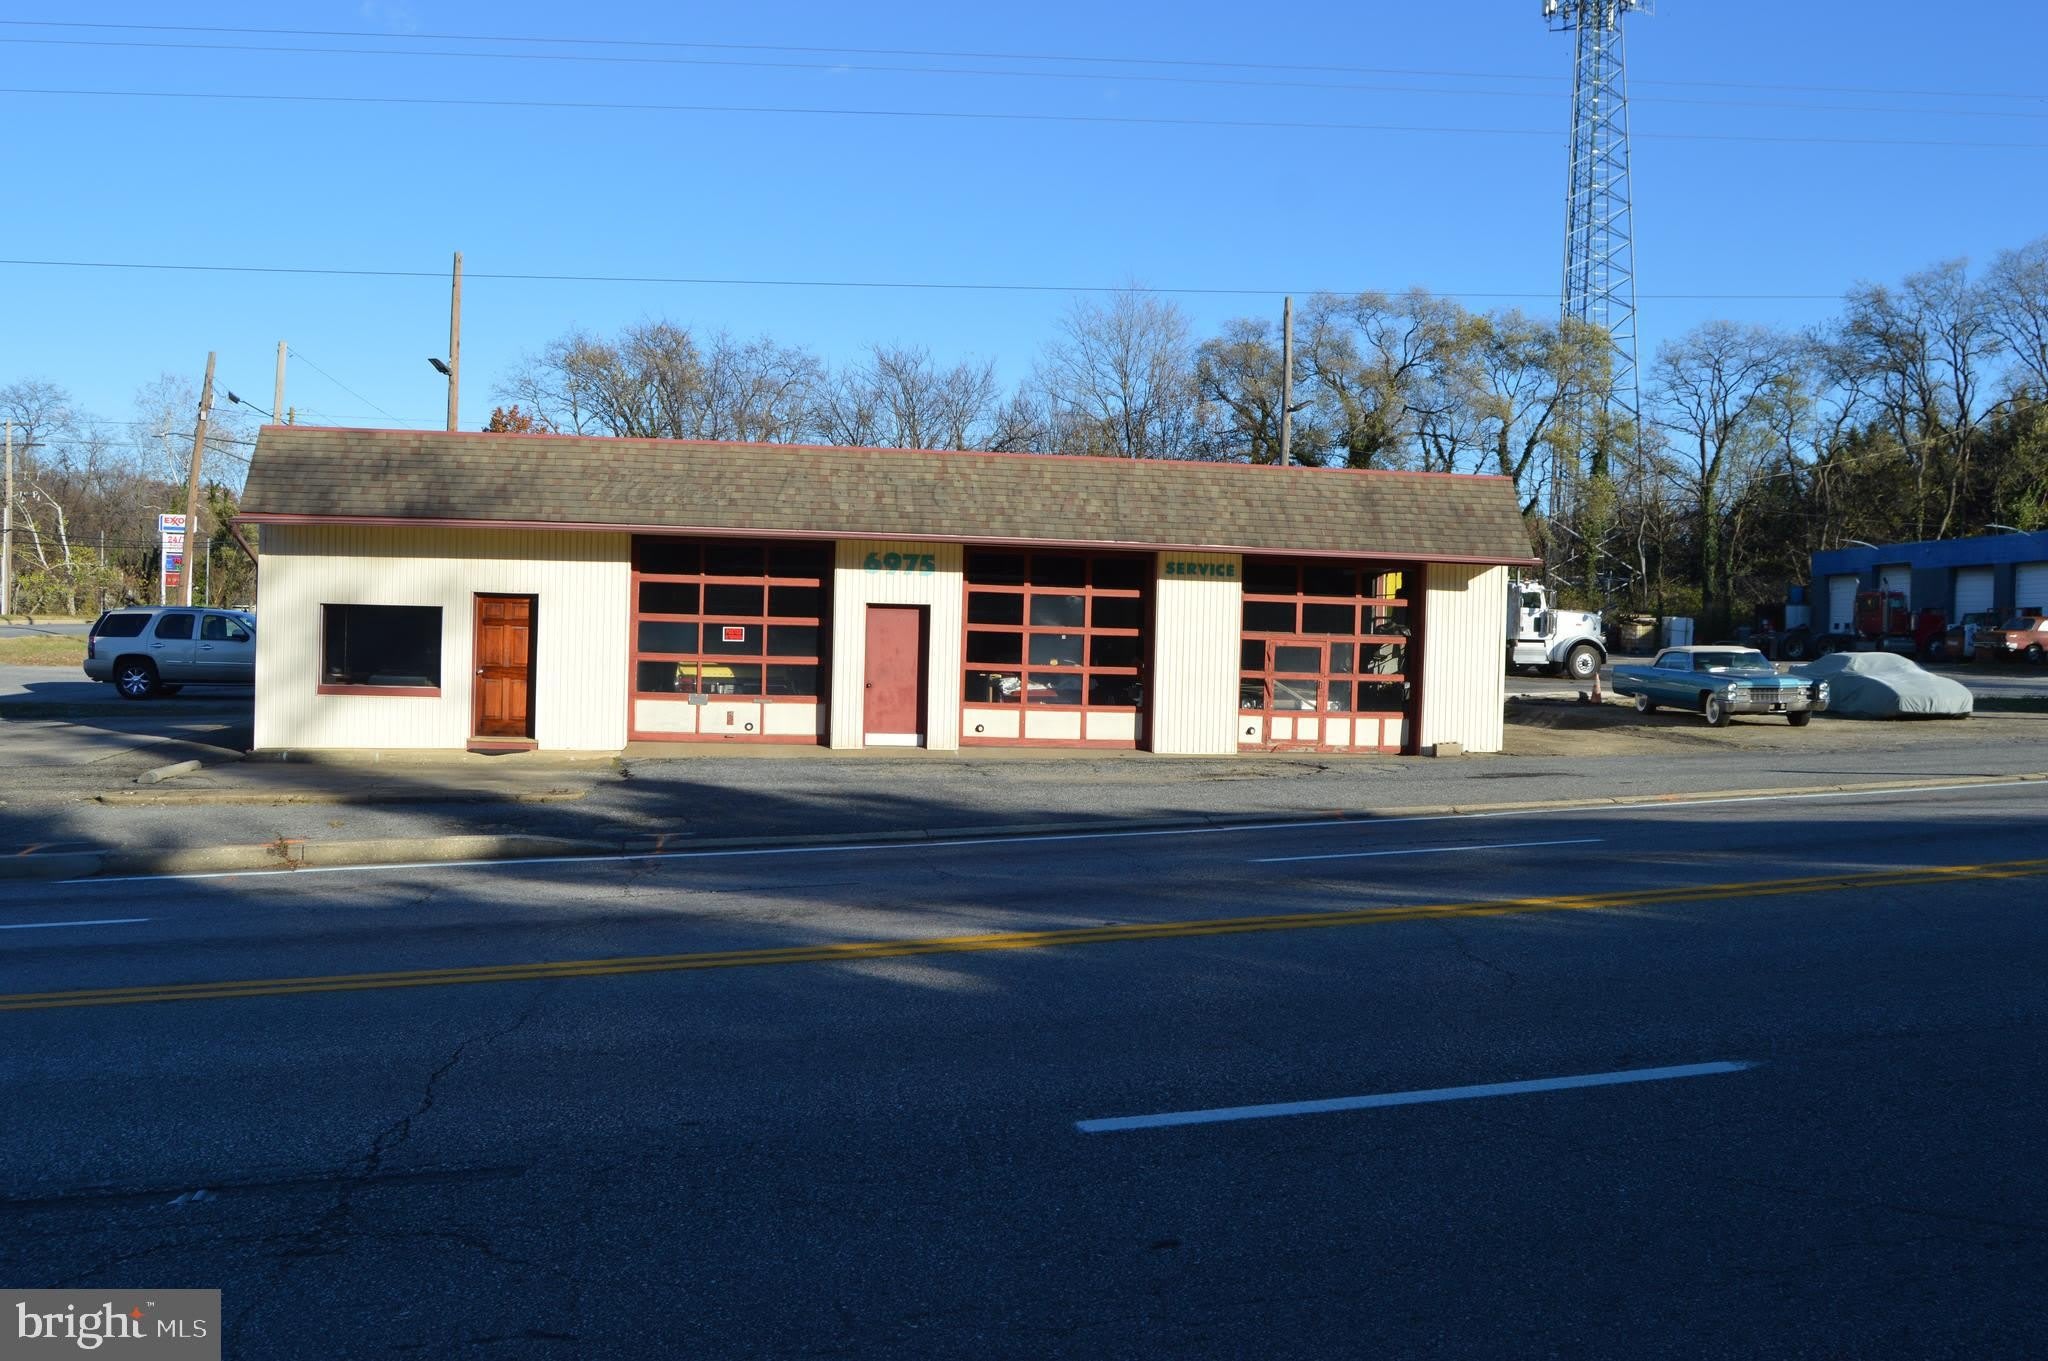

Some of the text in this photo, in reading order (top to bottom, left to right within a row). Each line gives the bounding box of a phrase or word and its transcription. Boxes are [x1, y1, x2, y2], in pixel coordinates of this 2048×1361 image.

[164, 516, 185, 526] EXXO
[167, 535, 184, 543] 24/
[863, 551, 936, 577] 6975
[1165, 561, 1235, 579] SERVICE
